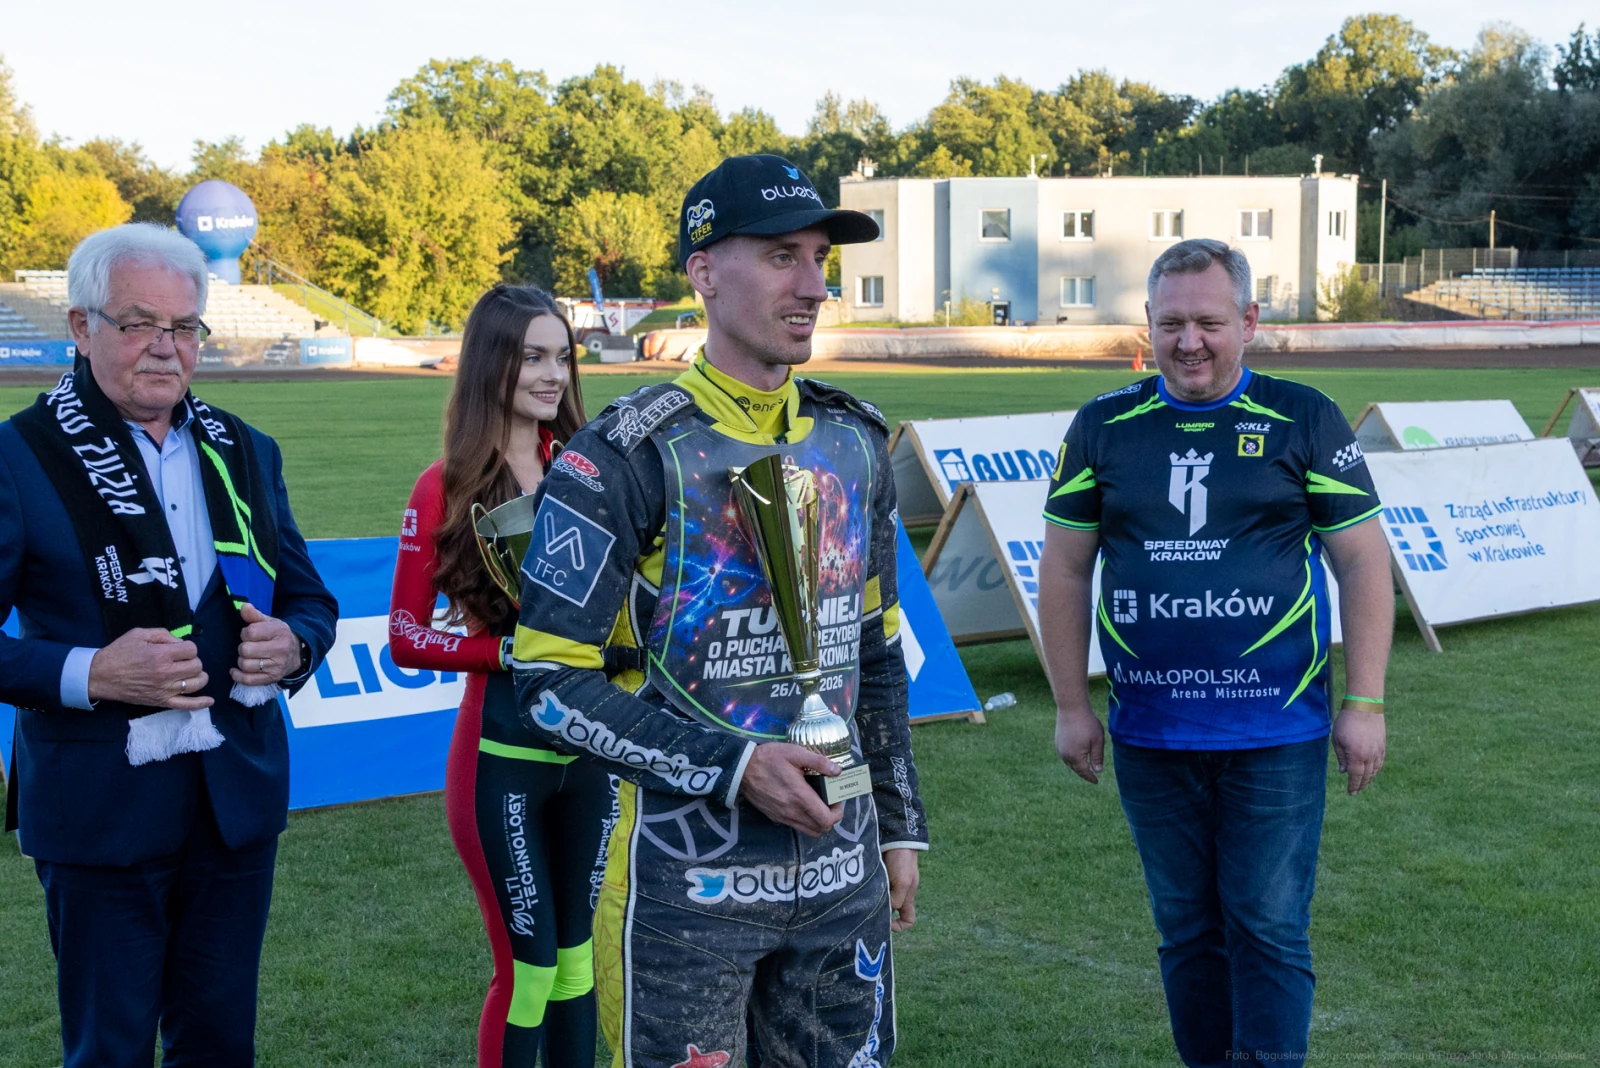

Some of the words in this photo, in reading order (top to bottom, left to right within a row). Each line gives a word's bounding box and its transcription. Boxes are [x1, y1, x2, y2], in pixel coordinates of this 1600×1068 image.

[1444, 500, 1493, 520] Zarząd
[1492, 489, 1587, 514] Infrastruktury
[1144, 538, 1230, 550] SPEEDWAY
[1455, 519, 1526, 545] Sportowej
[1150, 548, 1221, 561] KRAKÓW
[1467, 551, 1482, 562] w
[1483, 541, 1546, 562] Krakowie
[95, 556, 115, 599] KRAKÓW
[105, 545, 128, 602] SPEEDWAY
[535, 557, 567, 586] TFC
[721, 593, 860, 638] TUNIEJ
[1150, 588, 1274, 618] Kraków
[703, 657, 774, 680] MIASTA
[781, 644, 850, 673] KKOWA
[708, 642, 722, 659] O
[725, 635, 787, 658] PUCHA
[1130, 669, 1260, 685] MAŁOPOLSKA
[1171, 688, 1206, 699] Arena
[1215, 687, 1281, 699] Mistrzostw
[566, 716, 717, 792] bluebird
[508, 793, 539, 909] TECHNOLOGY
[733, 849, 862, 897] bluebird
